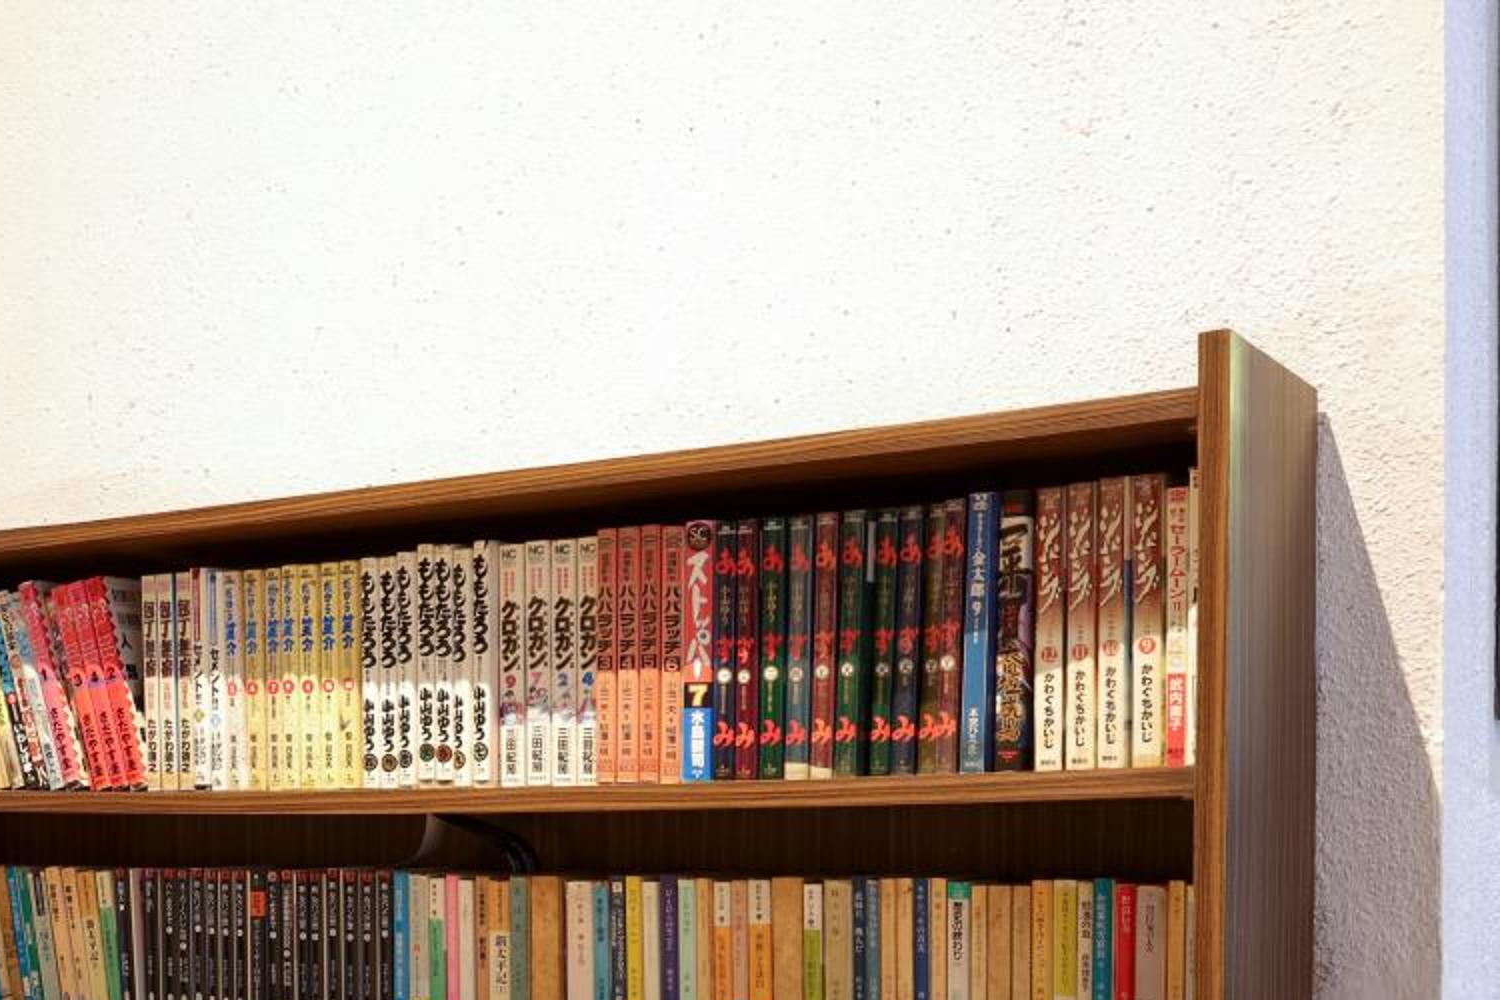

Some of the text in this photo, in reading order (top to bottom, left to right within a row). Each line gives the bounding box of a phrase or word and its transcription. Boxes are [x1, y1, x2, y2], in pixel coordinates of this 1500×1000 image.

[505, 675, 516, 689] 9
[531, 672, 543, 685] 7
[557, 673, 568, 686] 2
[581, 672, 594, 686] 4
[689, 684, 708, 706] 7
[1106, 667, 1117, 745] かわぐちかいじ
[1141, 664, 1153, 743] かわぐちかいじ
[1043, 673, 1054, 749] かわぐちかいじ
[1075, 670, 1084, 747] かわぐちかいじ
